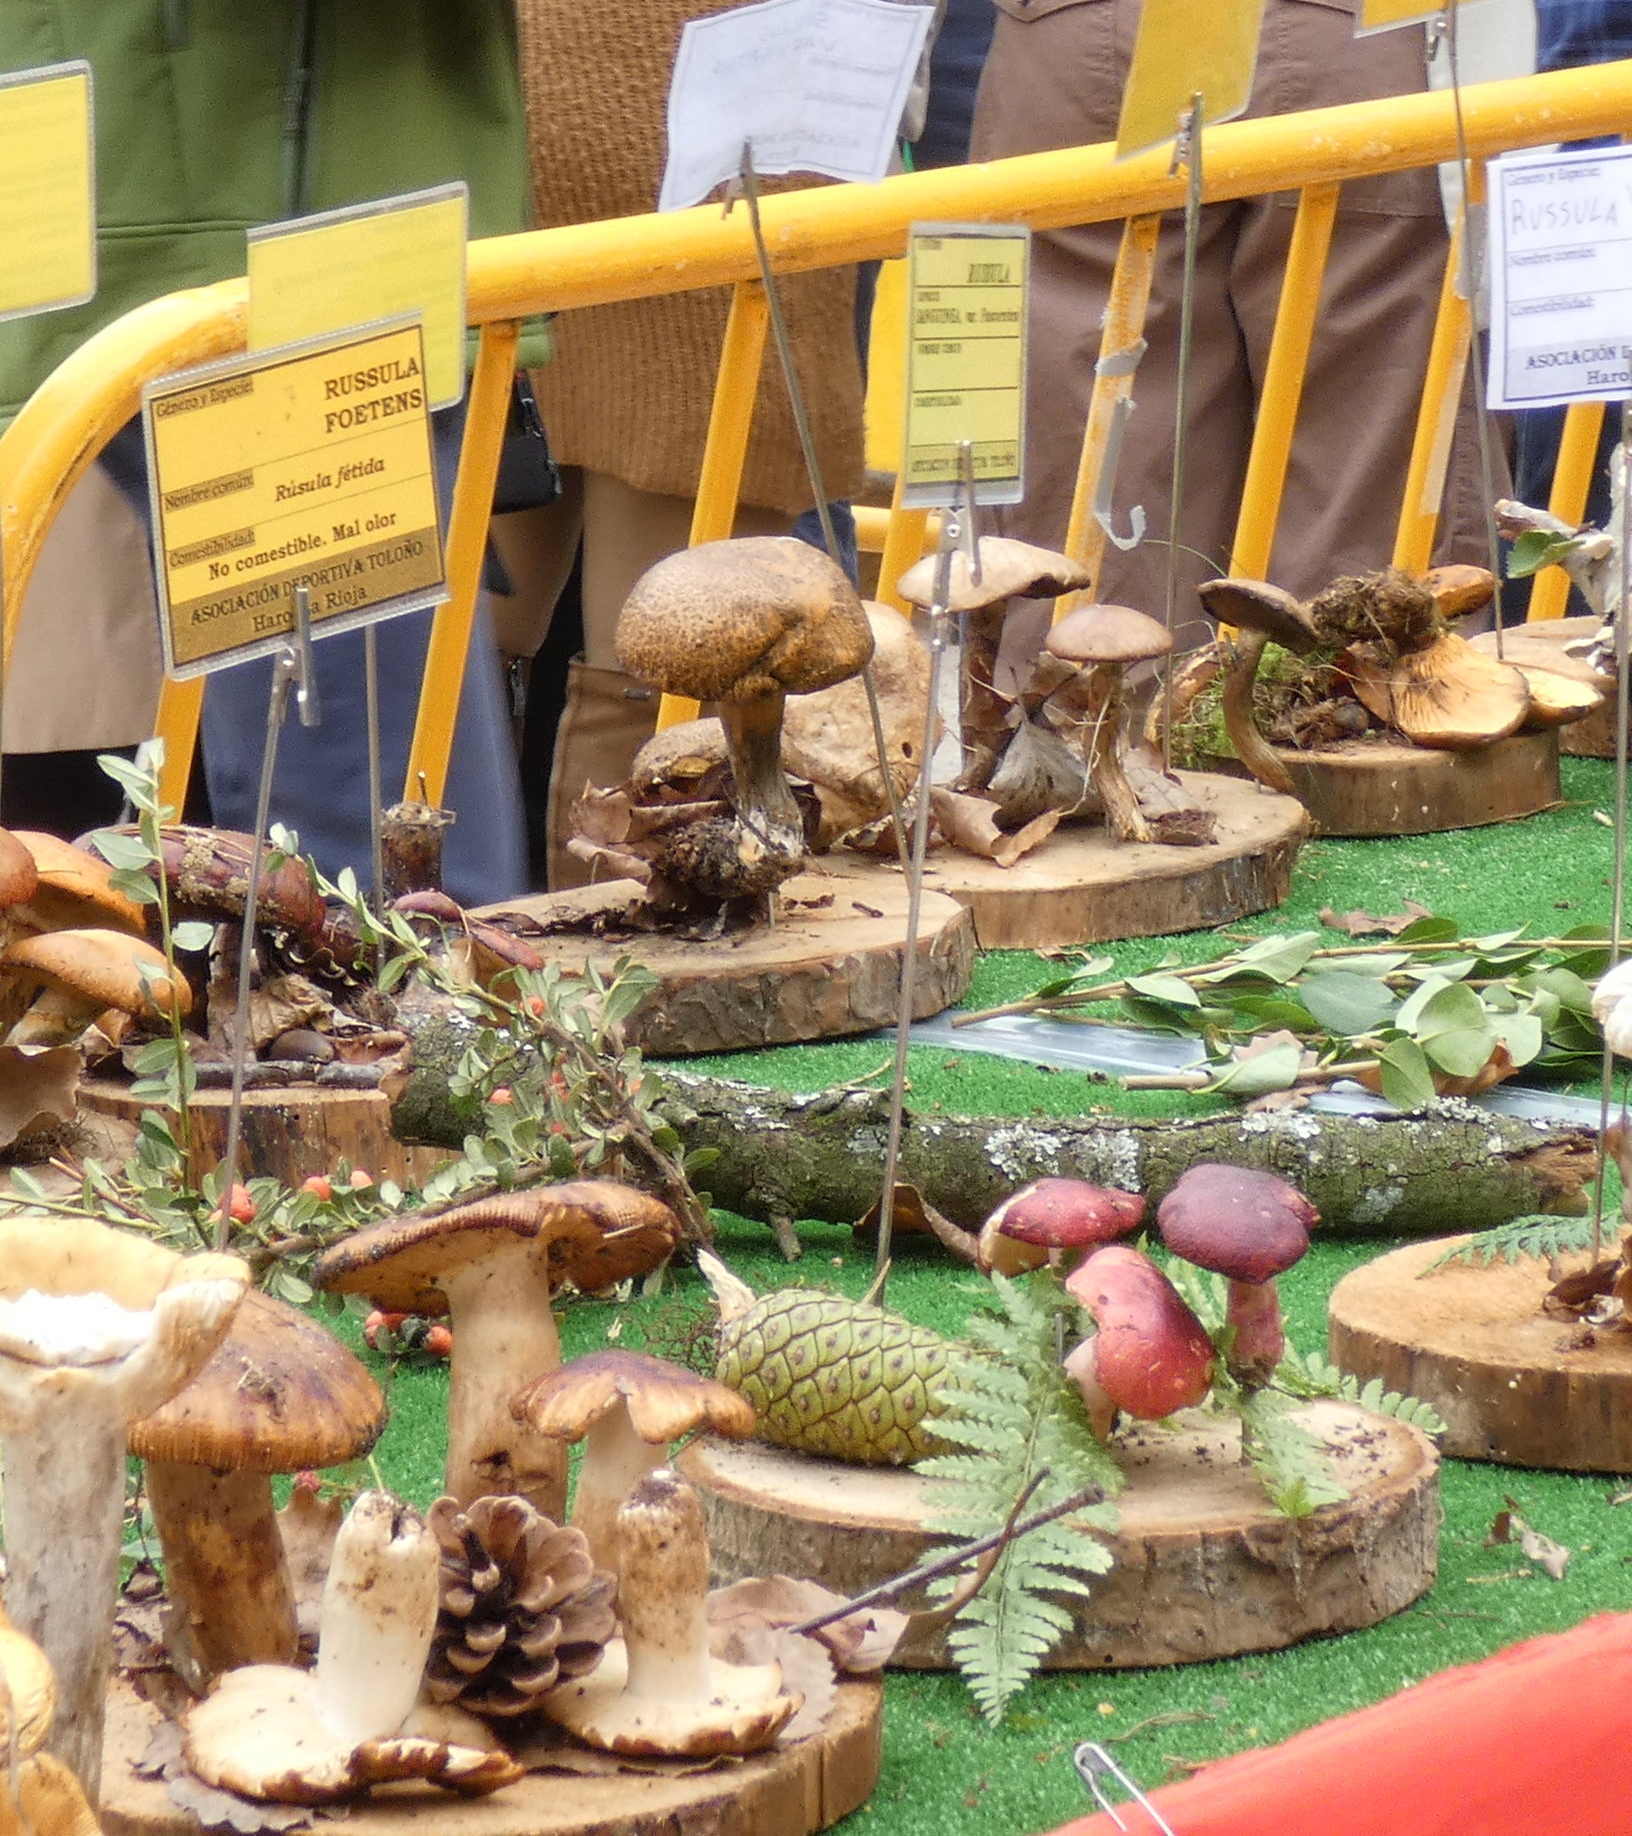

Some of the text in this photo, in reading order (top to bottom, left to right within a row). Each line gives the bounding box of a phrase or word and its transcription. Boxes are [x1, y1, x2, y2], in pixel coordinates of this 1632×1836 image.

[1511, 198, 1619, 235] RUSSULA
[324, 356, 420, 400] RUSSULA
[1525, 343, 1616, 370] ASOCIACIÓN
[325, 388, 423, 434] FOETENS
[275, 457, 386, 502] Rúsula fétida
[209, 510, 397, 581] No comestible. Mal olor
[191, 580, 280, 627] ASOCIACIÓN
[367, 540, 424, 574] TOLOÑO
[326, 584, 368, 612] Rioja
